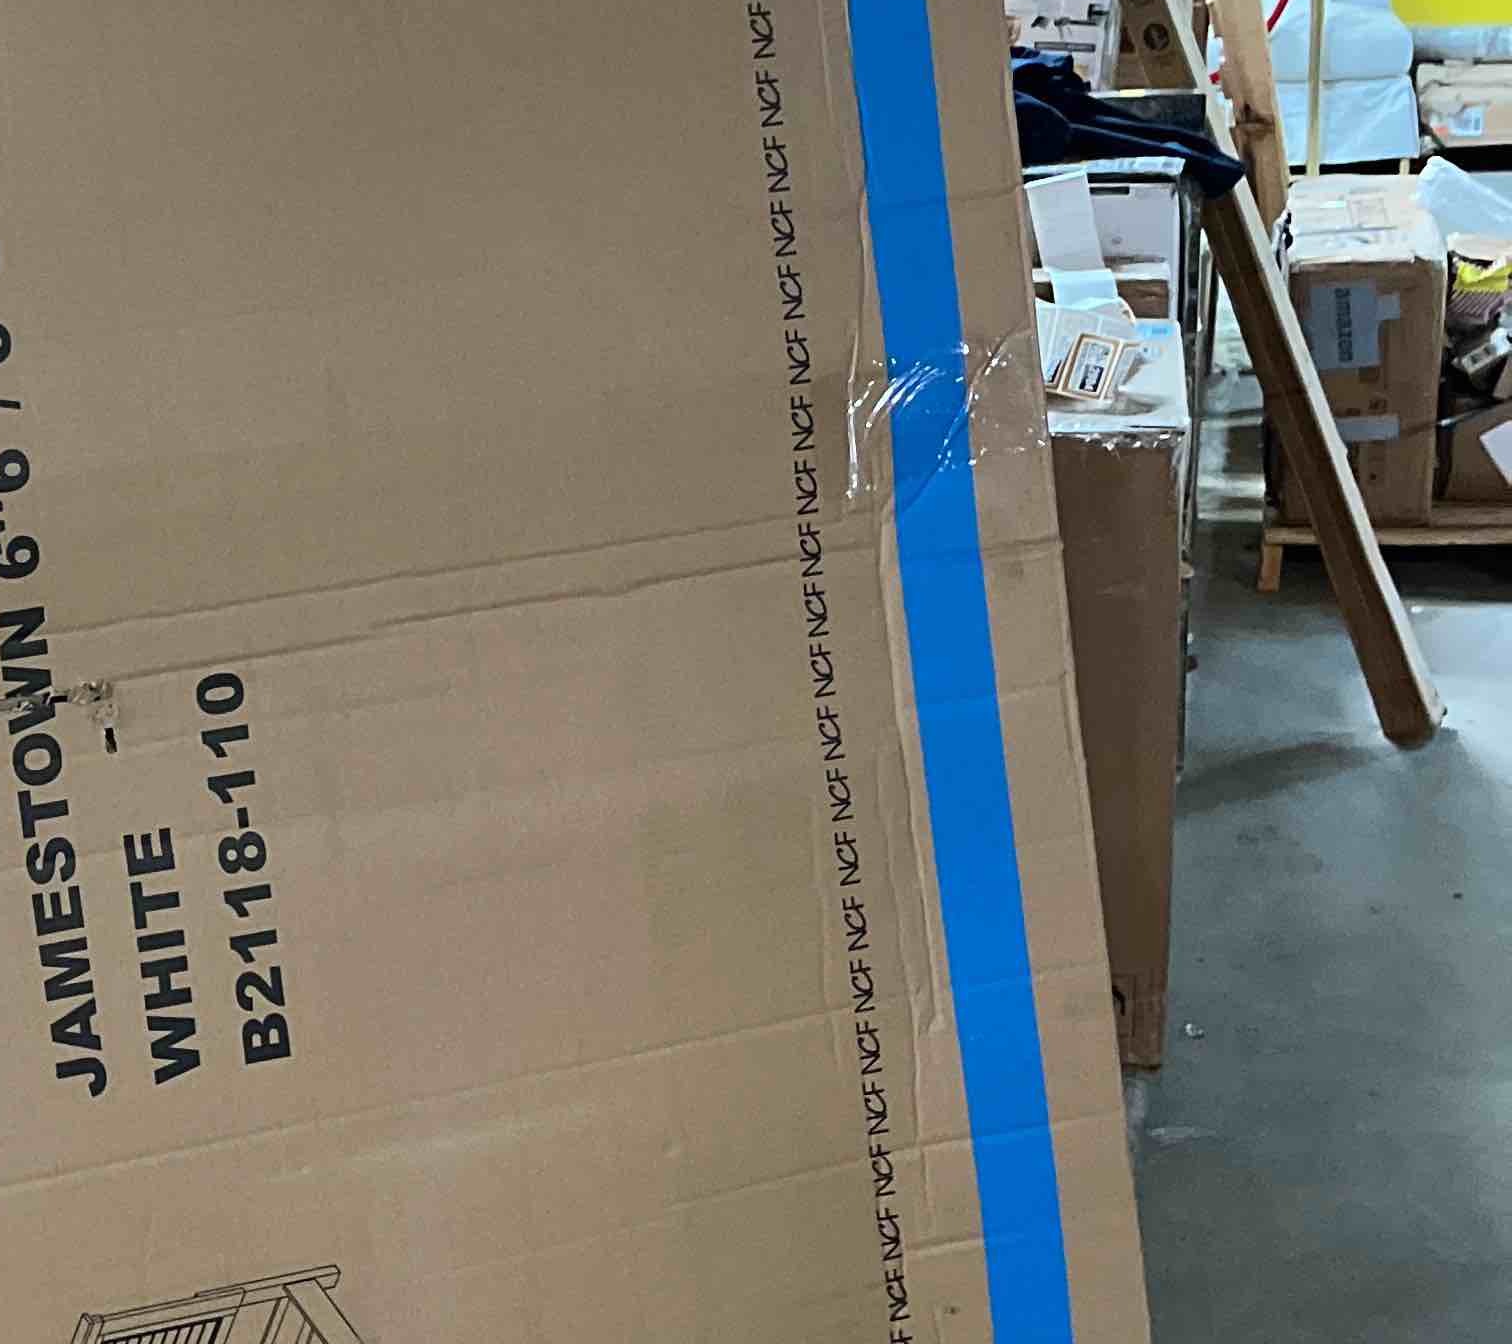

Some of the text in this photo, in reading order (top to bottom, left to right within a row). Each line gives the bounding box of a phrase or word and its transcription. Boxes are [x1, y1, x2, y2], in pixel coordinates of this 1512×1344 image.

[748, 2, 776, 59] NCF
[756, 70, 783, 127] NCF
[763, 136, 790, 192] NCF
[770, 200, 797, 257] NCF
[777, 264, 805, 320] NCF
[1333, 287, 1352, 363] amazon
[785, 329, 812, 385] NCF
[790, 395, 816, 451] NCF
[794, 459, 819, 515] NCF
[798, 522, 823, 577] NCF
[804, 582, 829, 637] NCF
[809, 643, 836, 698] NCF
[816, 706, 845, 761] NCF
[826, 768, 853, 822] NCF
[197, 669, 292, 1066] B2118-110
[834, 832, 861, 886] NCF
[842, 896, 869, 952] NCF
[123, 828, 200, 1085] WHITE
[849, 959, 875, 1013] NCF
[856, 1021, 883, 1076] NCF
[862, 1082, 890, 1136] NCF
[869, 1144, 896, 1203] NCF
[875, 1203, 903, 1263] NCF
[884, 1263, 911, 1322] NCF
